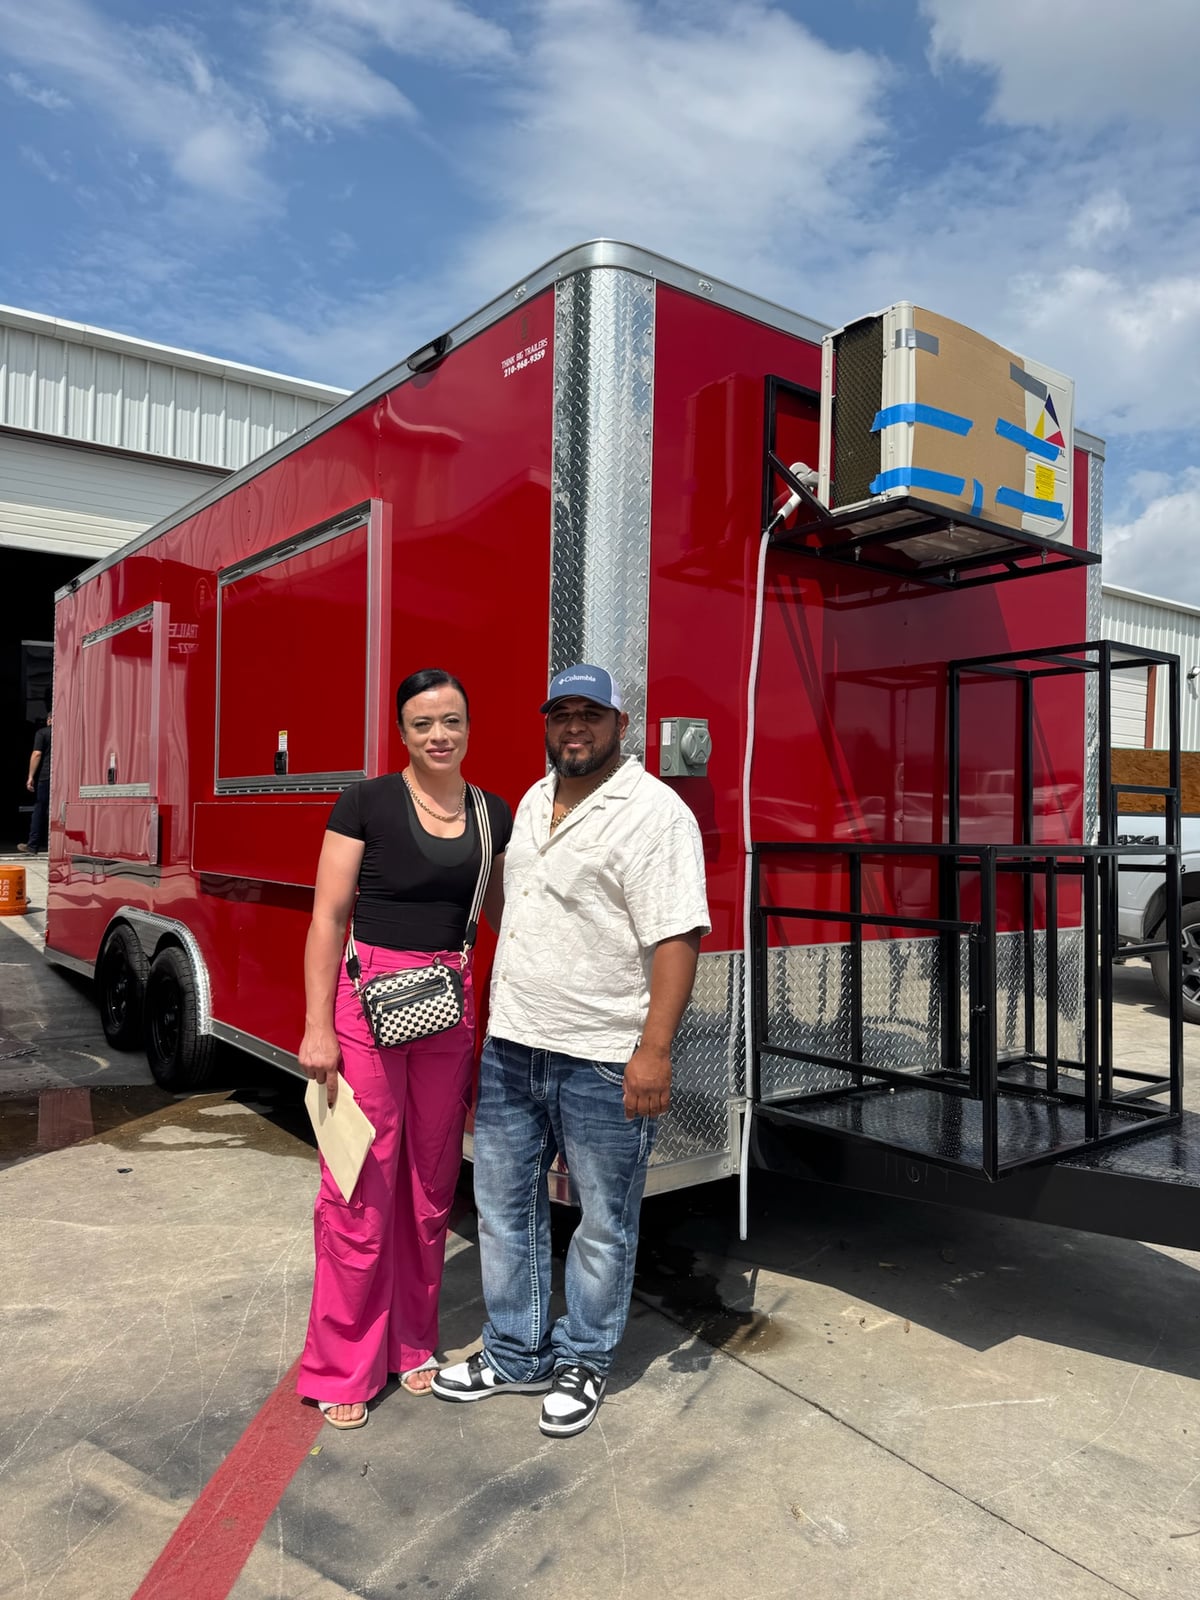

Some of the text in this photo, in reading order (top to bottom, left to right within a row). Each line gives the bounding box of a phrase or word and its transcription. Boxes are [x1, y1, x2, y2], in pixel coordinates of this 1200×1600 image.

[501, 338, 548, 369] THINK BIG TRAILERS
[564, 674, 596, 683] Columbia
